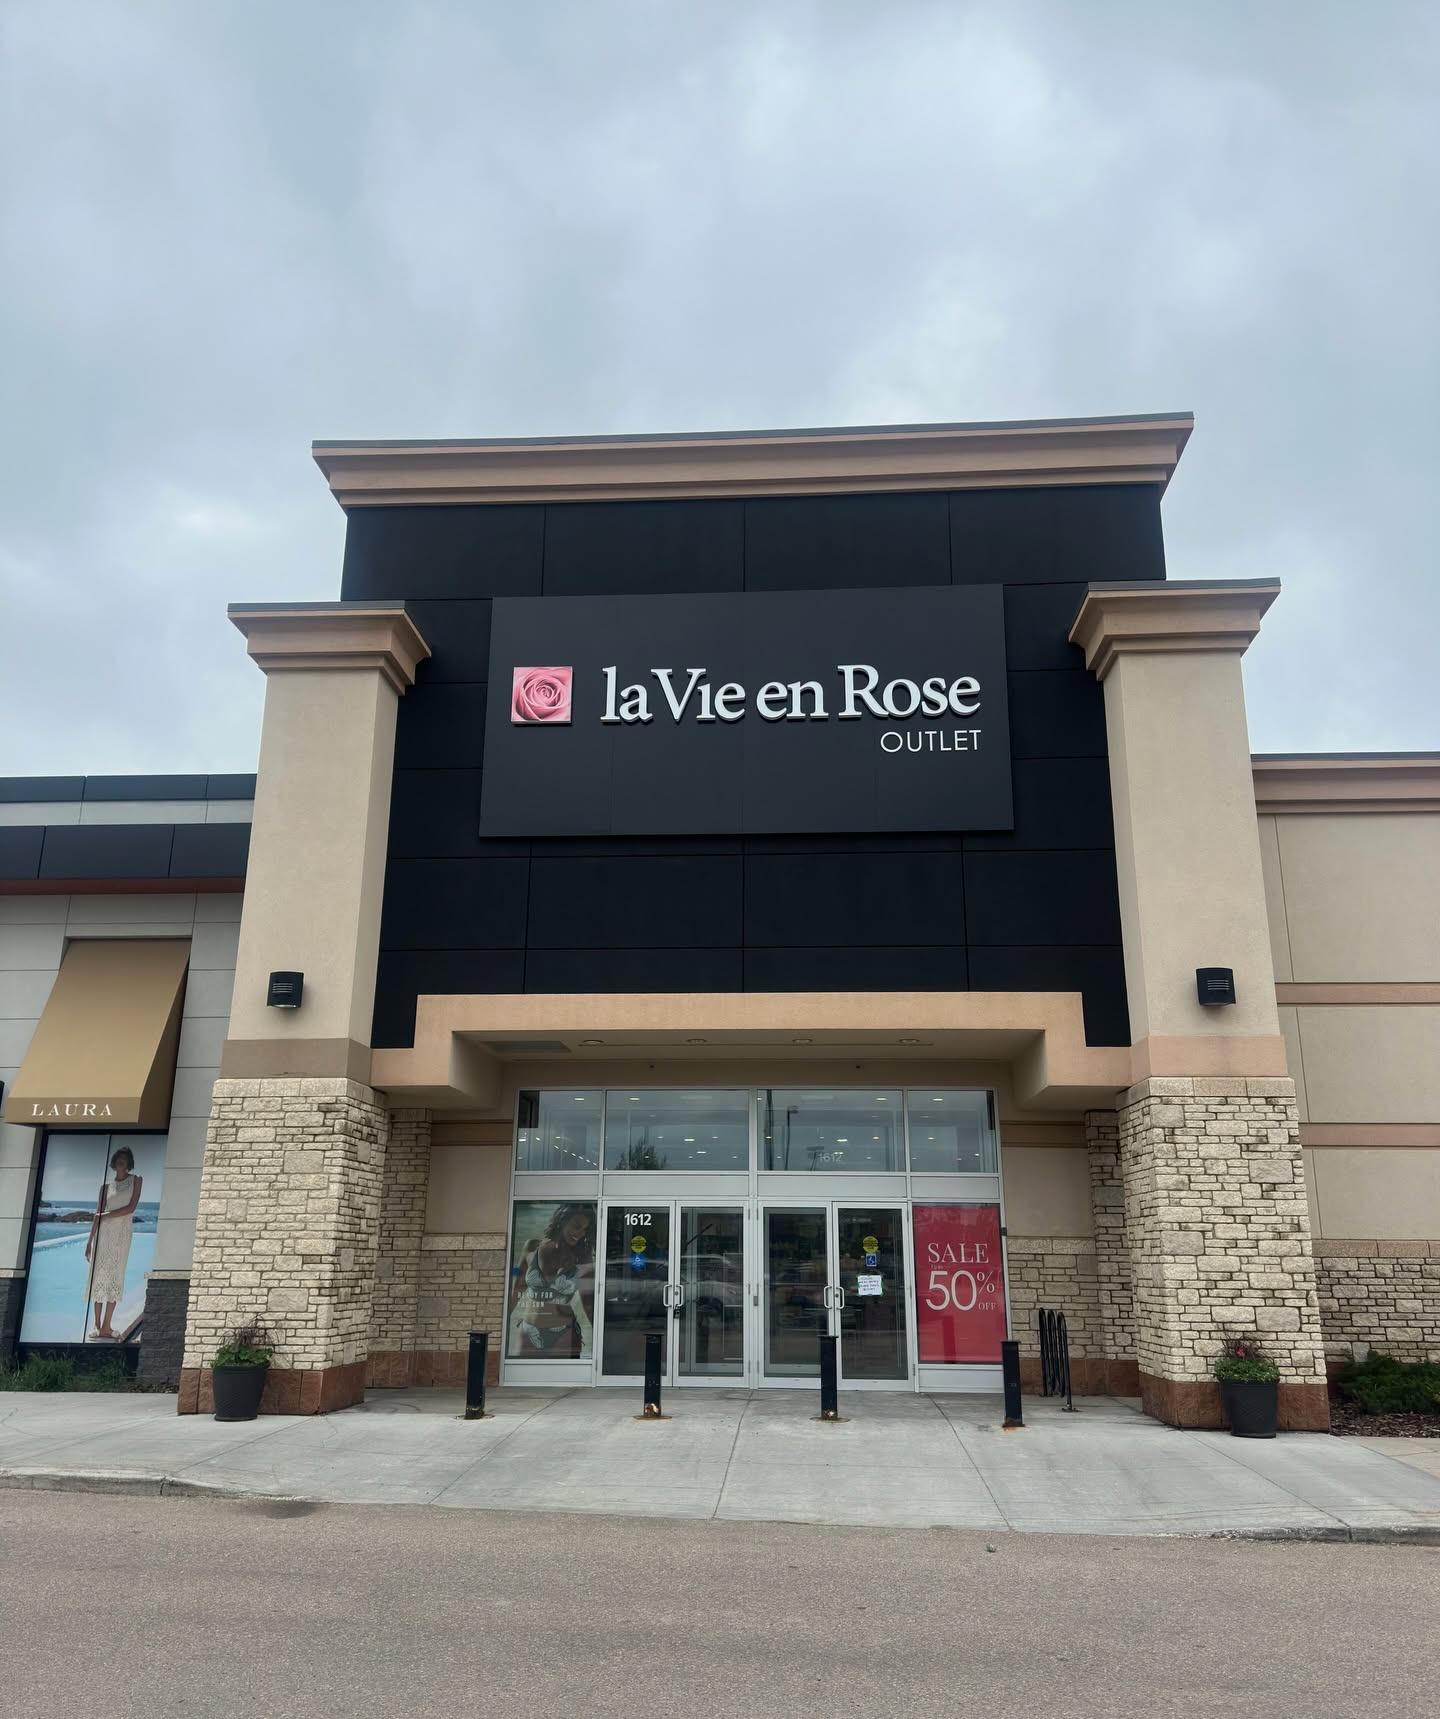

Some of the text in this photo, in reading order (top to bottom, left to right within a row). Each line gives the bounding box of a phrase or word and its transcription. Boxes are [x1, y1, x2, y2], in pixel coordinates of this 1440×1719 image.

[600, 664, 982, 723] la Vie en Rose
[880, 729, 982, 753] OUTLET
[31, 1103, 113, 1117] LAURA
[624, 1213, 652, 1226] 1612
[928, 1242, 989, 1264] SALE
[925, 1270, 996, 1311] 50%
[978, 1302, 996, 1311] OFF
